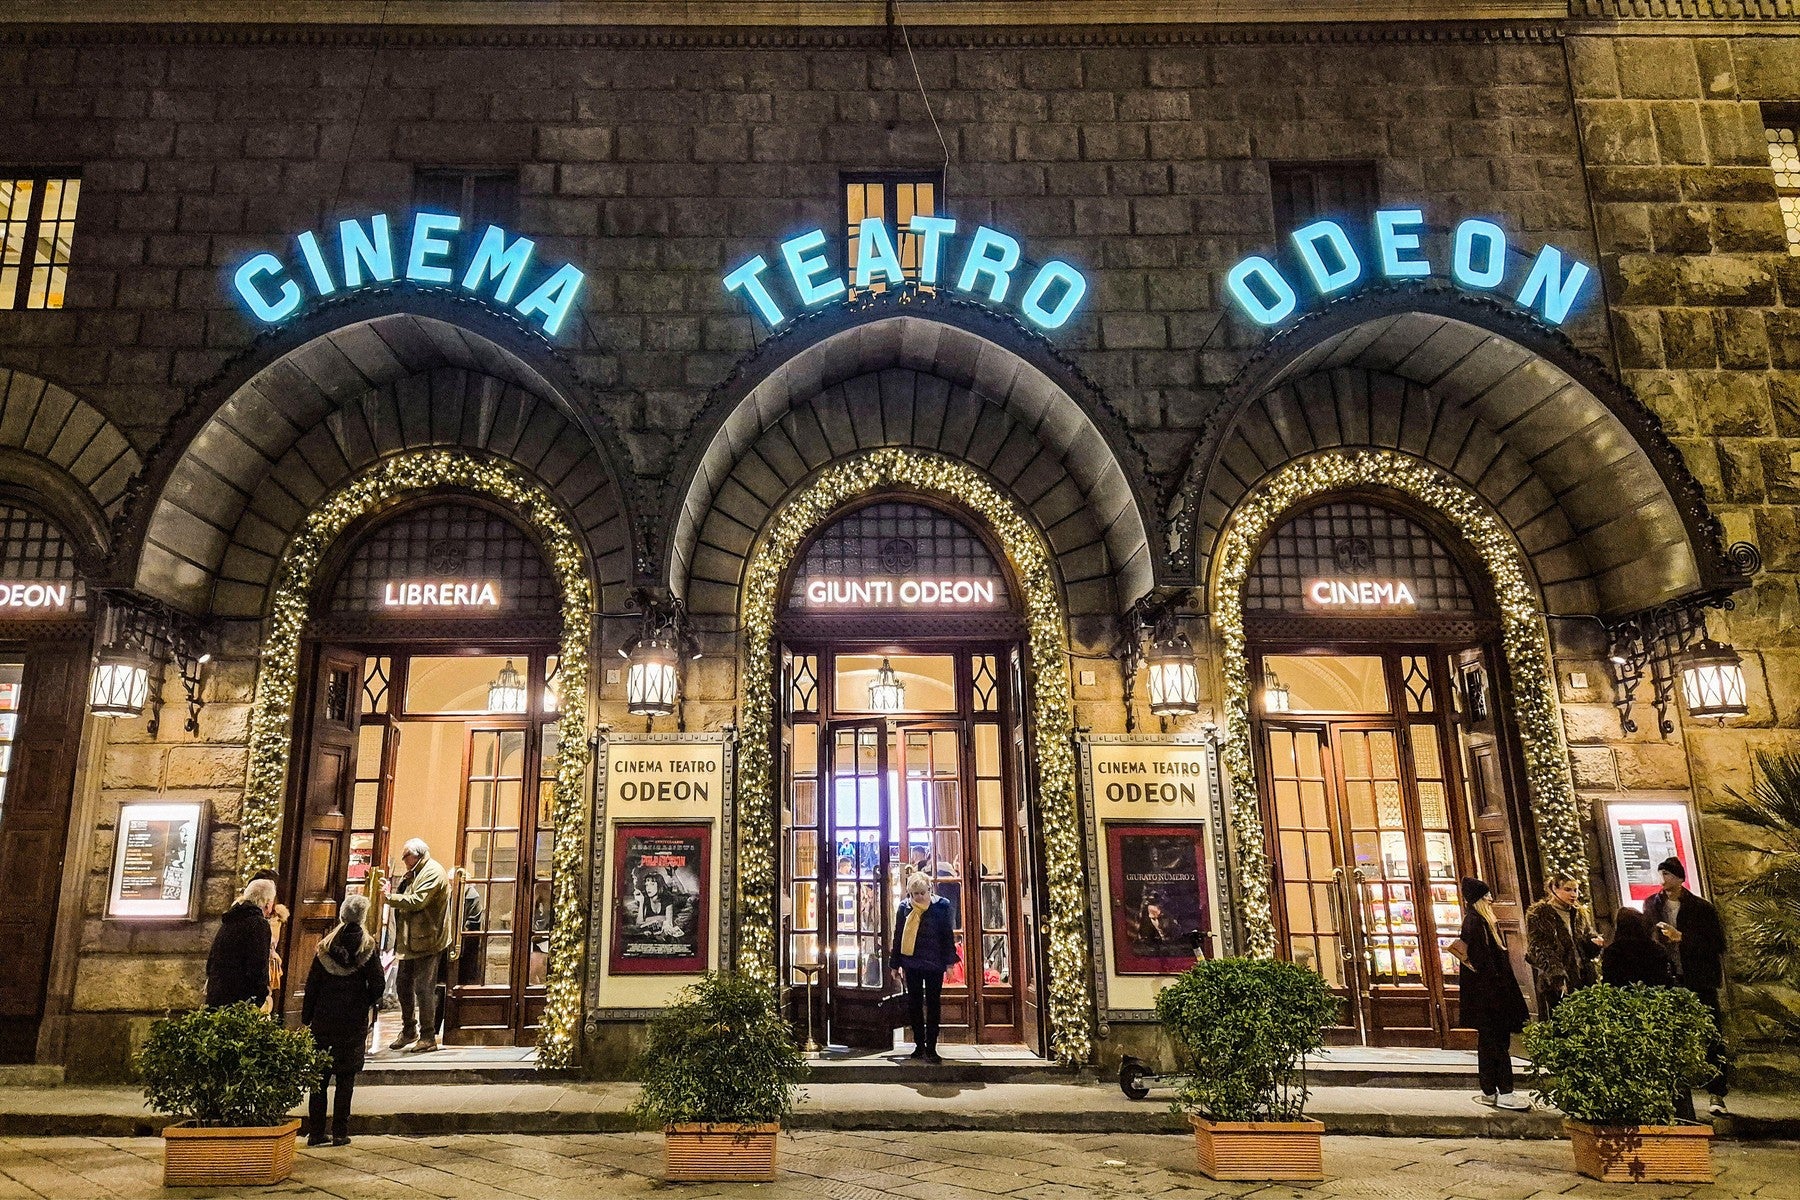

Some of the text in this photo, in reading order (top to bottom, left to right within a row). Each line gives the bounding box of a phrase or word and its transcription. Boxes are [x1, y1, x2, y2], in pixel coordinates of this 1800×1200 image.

[234, 213, 584, 335] CINEMA
[723, 215, 1086, 329] TEATRO
[1228, 210, 1590, 325] ODEON
[384, 582, 498, 605] LIBRERIA
[807, 580, 994, 603] GIUNTI ODEON
[1311, 581, 1415, 604] CINEMA
[614, 760, 717, 773] CINEMA TEATRO
[1097, 761, 1201, 775] CINEMA TEATRO
[619, 781, 709, 802] ODEON
[1105, 782, 1196, 804] ODEON
[1126, 872, 1196, 881] GIURATO NUMERO 2
